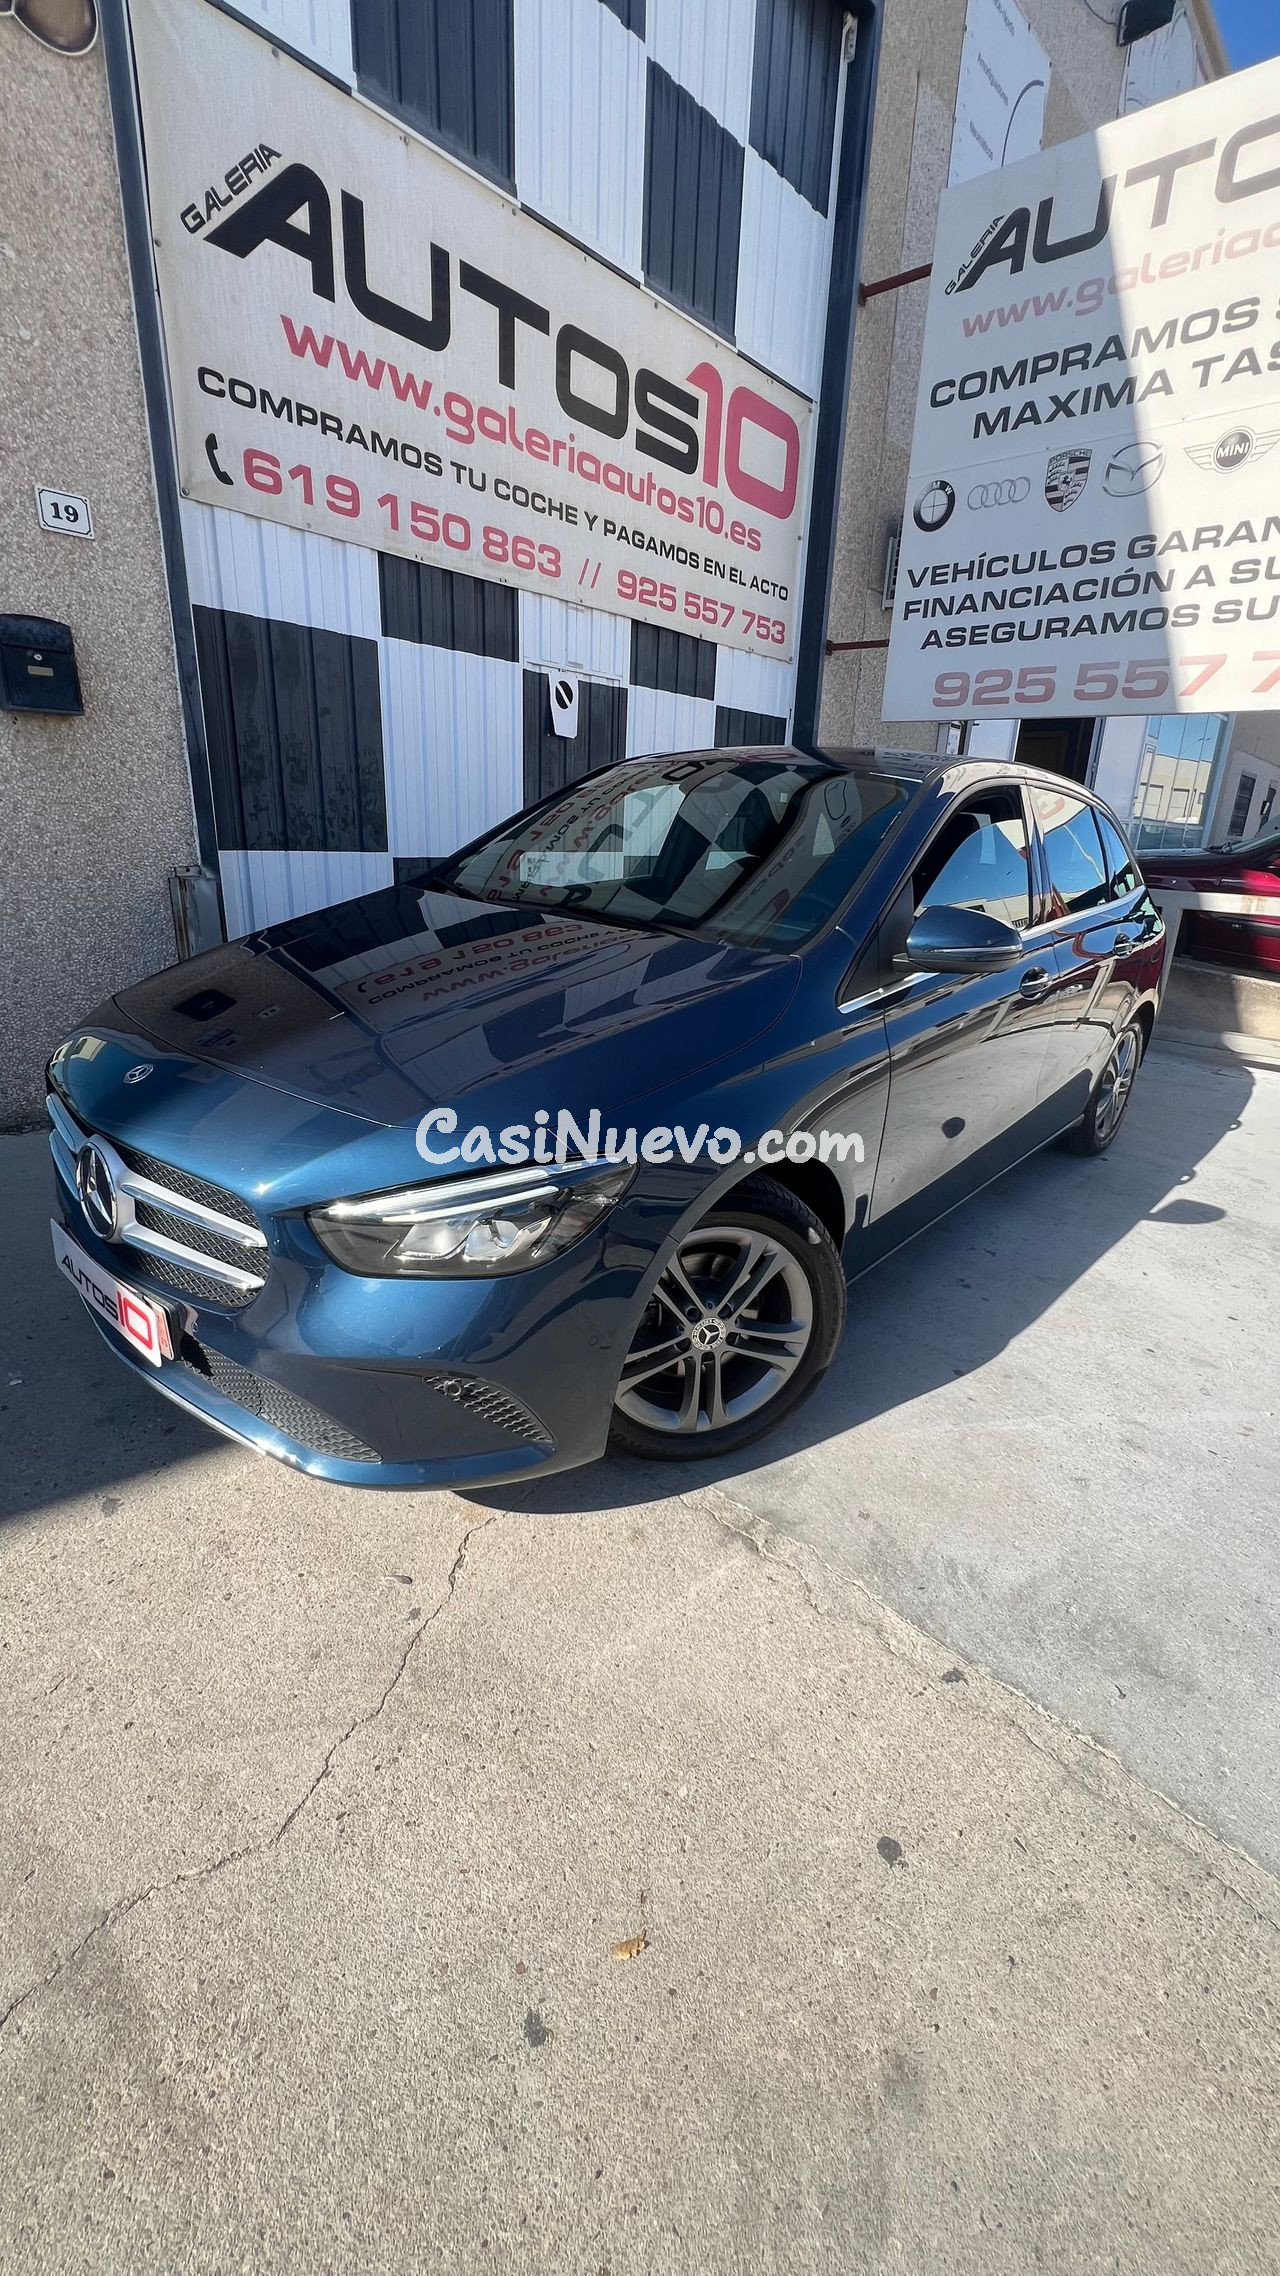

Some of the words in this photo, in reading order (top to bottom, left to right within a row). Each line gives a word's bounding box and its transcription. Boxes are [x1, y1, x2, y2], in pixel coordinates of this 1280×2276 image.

[180, 143, 282, 234] GALERIA
[944, 215, 1005, 296] GALERIA
[203, 163, 800, 520] AUTOS10
[930, 296, 1260, 408] COMPRAMOS
[280, 314, 762, 552] www.galeriaautos10.es
[973, 369, 1175, 438] MAXIMA
[197, 366, 443, 477] COMPRAMOS
[449, 461, 487, 493] TU
[493, 478, 578, 525] COCHE
[584, 511, 599, 532] Y
[603, 519, 700, 570] PAGAMOS
[704, 558, 726, 580] EN
[729, 567, 747, 588] EL
[749, 575, 789, 601] ACTO
[1217, 441, 1250, 459] MINI
[50, 502, 79, 523] 19
[243, 448, 361, 519] 619
[377, 493, 471, 551] 150
[482, 525, 562, 578] 863
[617, 569, 677, 612] 925
[684, 592, 734, 630] 557
[741, 609, 786, 645] 753
[903, 567, 1175, 620] FINANCIACIÓN
[1183, 564, 1216, 591] A
[907, 540, 1116, 588] VEHÍCULOS
[920, 604, 1200, 650] ASEGURAMOS
[1212, 595, 1280, 624] SU
[932, 666, 1058, 708] 925
[1073, 653, 1228, 701] 557
[61, 1254, 153, 1350] AUTOS10
